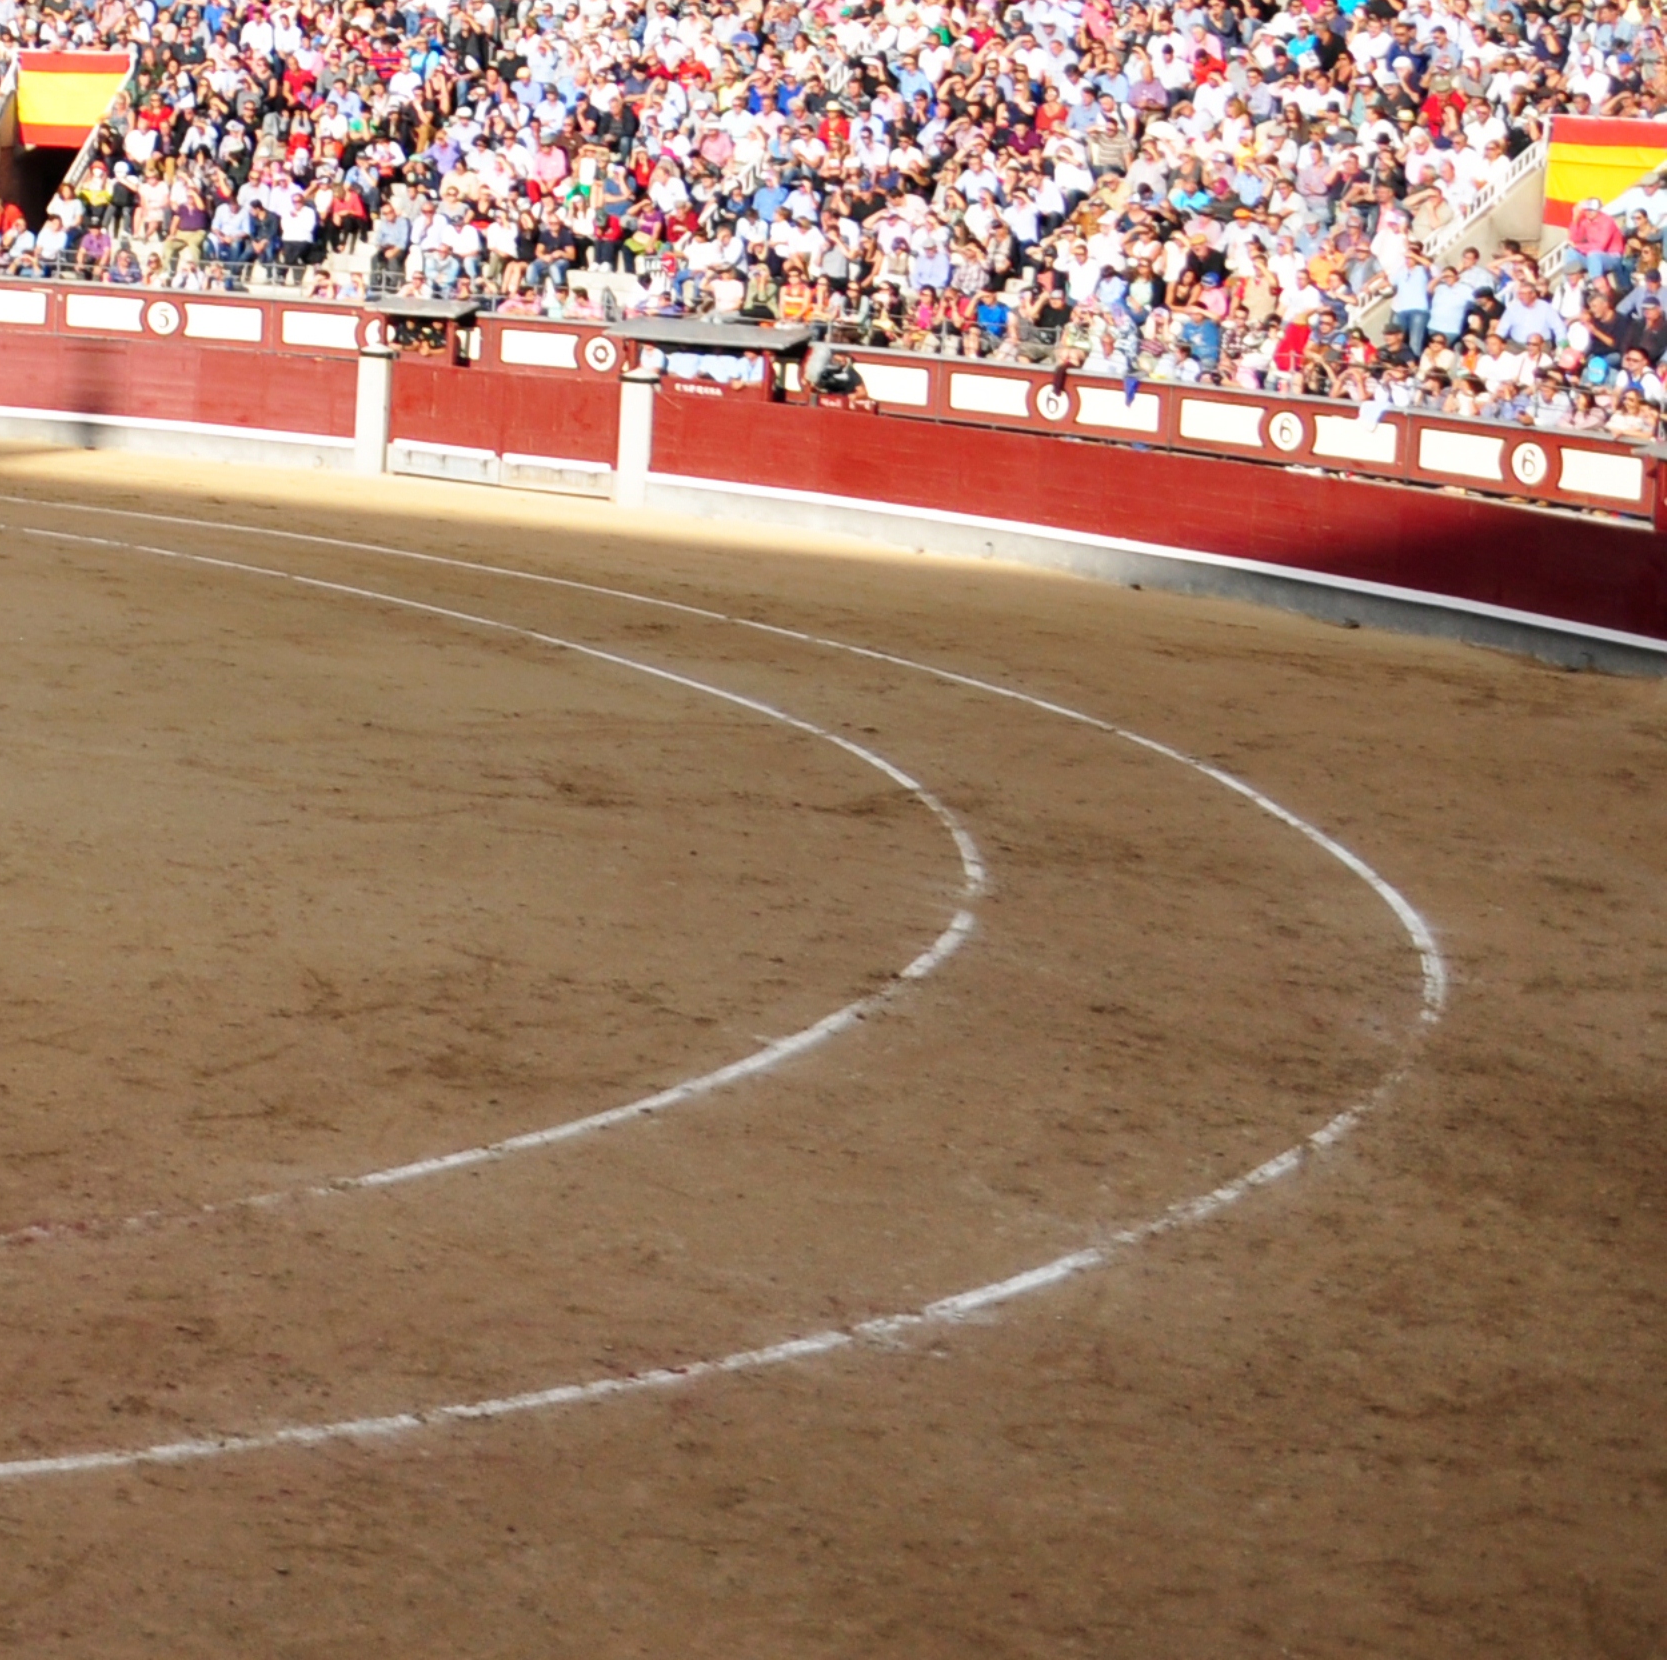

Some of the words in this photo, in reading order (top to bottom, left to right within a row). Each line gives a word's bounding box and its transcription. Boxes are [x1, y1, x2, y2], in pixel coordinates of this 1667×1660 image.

[157, 308, 170, 329] 5
[1046, 391, 1059, 413] 6
[1279, 419, 1293, 443] 6
[1521, 449, 1536, 476] 6
